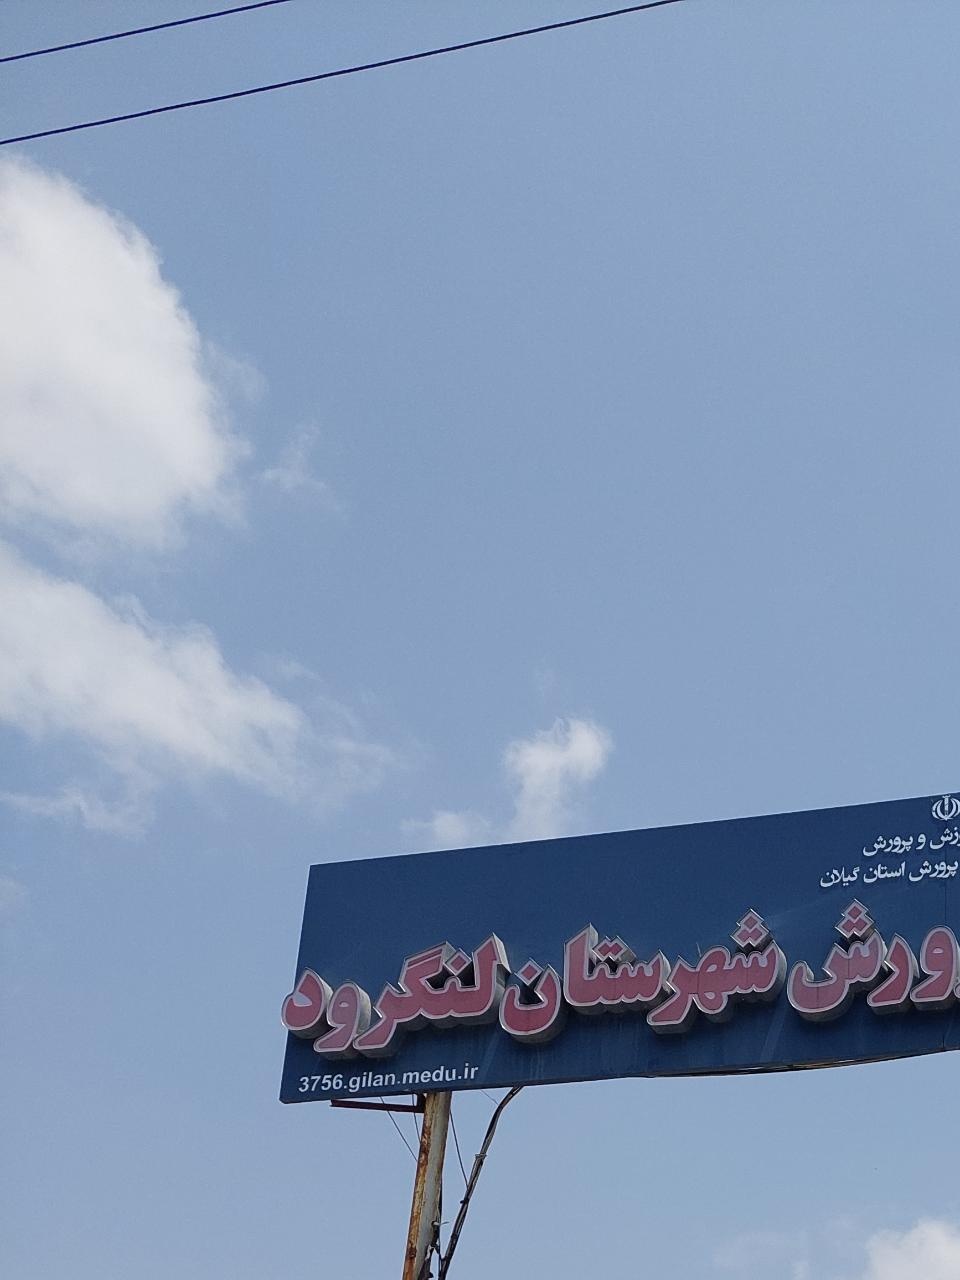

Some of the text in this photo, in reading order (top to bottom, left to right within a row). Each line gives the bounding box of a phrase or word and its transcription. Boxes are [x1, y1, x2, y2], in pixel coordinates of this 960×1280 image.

[862, 835, 914, 857] پرورش
[915, 833, 927, 850] و
[820, 866, 860, 888] گیلان
[863, 861, 906, 883] استان
[908, 859, 958, 882] پرورش
[500, 908, 789, 1045] شهرستان
[281, 932, 508, 1058] لنگرود
[298, 1062, 479, 1093] 3756.gilan.medu.ir
